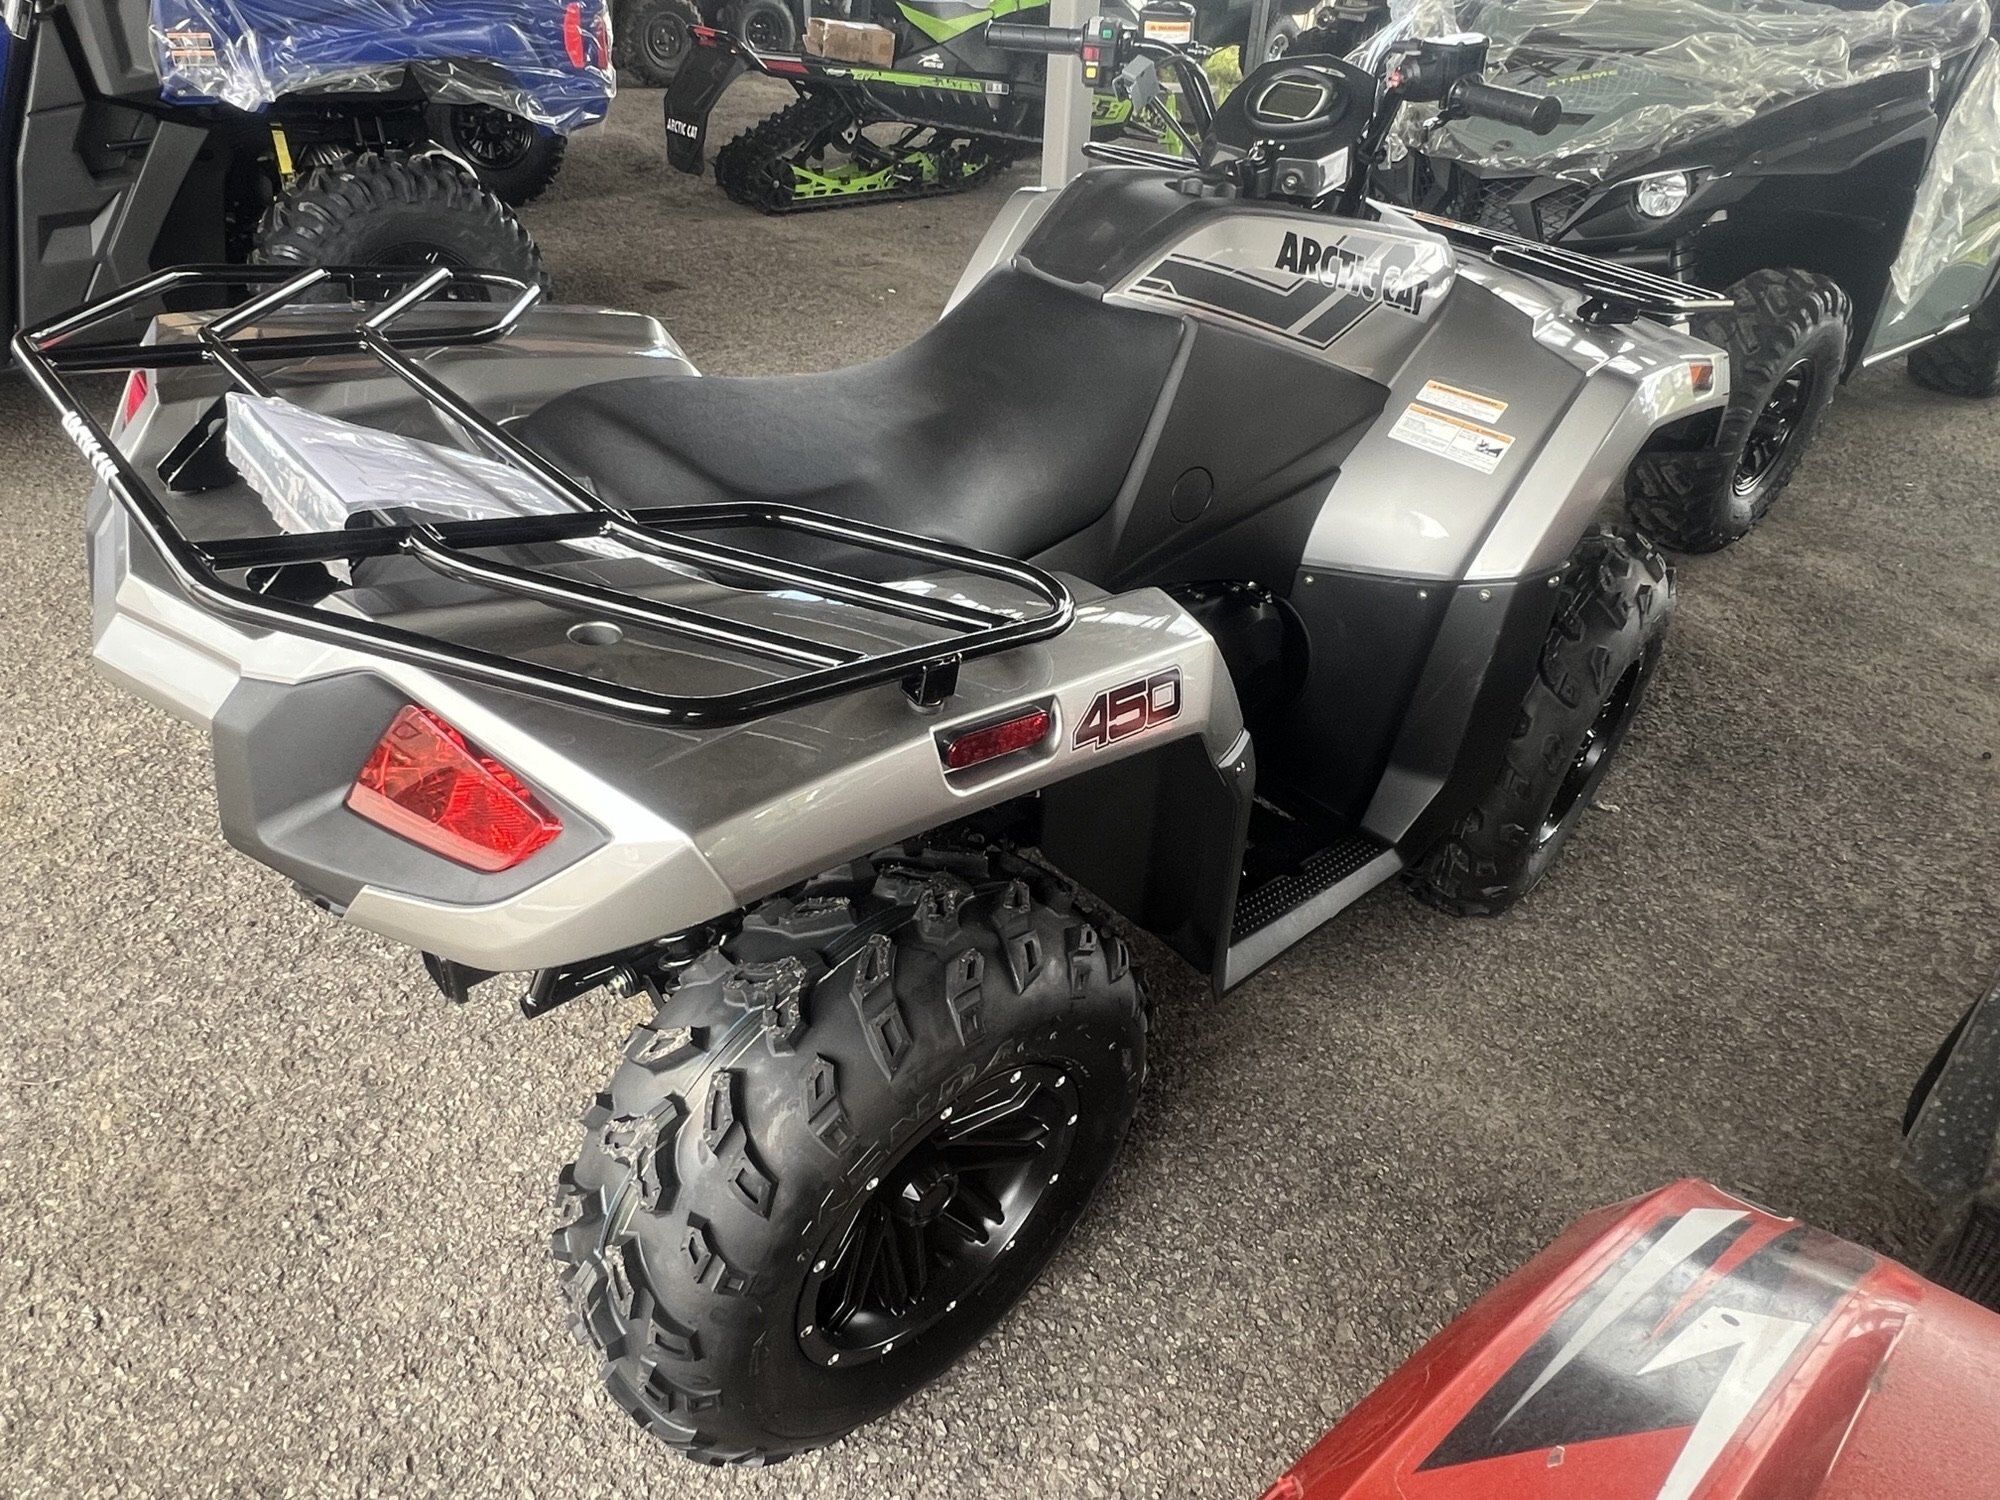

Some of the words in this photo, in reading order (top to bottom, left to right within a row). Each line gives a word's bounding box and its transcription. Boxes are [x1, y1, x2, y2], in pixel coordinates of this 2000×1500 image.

[1546, 69, 1618, 87] XTREME
[667, 118, 686, 136] ARCTIC
[687, 124, 698, 139] CAT
[1274, 231, 1381, 302] ARCTIC
[1382, 266, 1429, 316] CAT
[1071, 664, 1183, 753] 450
